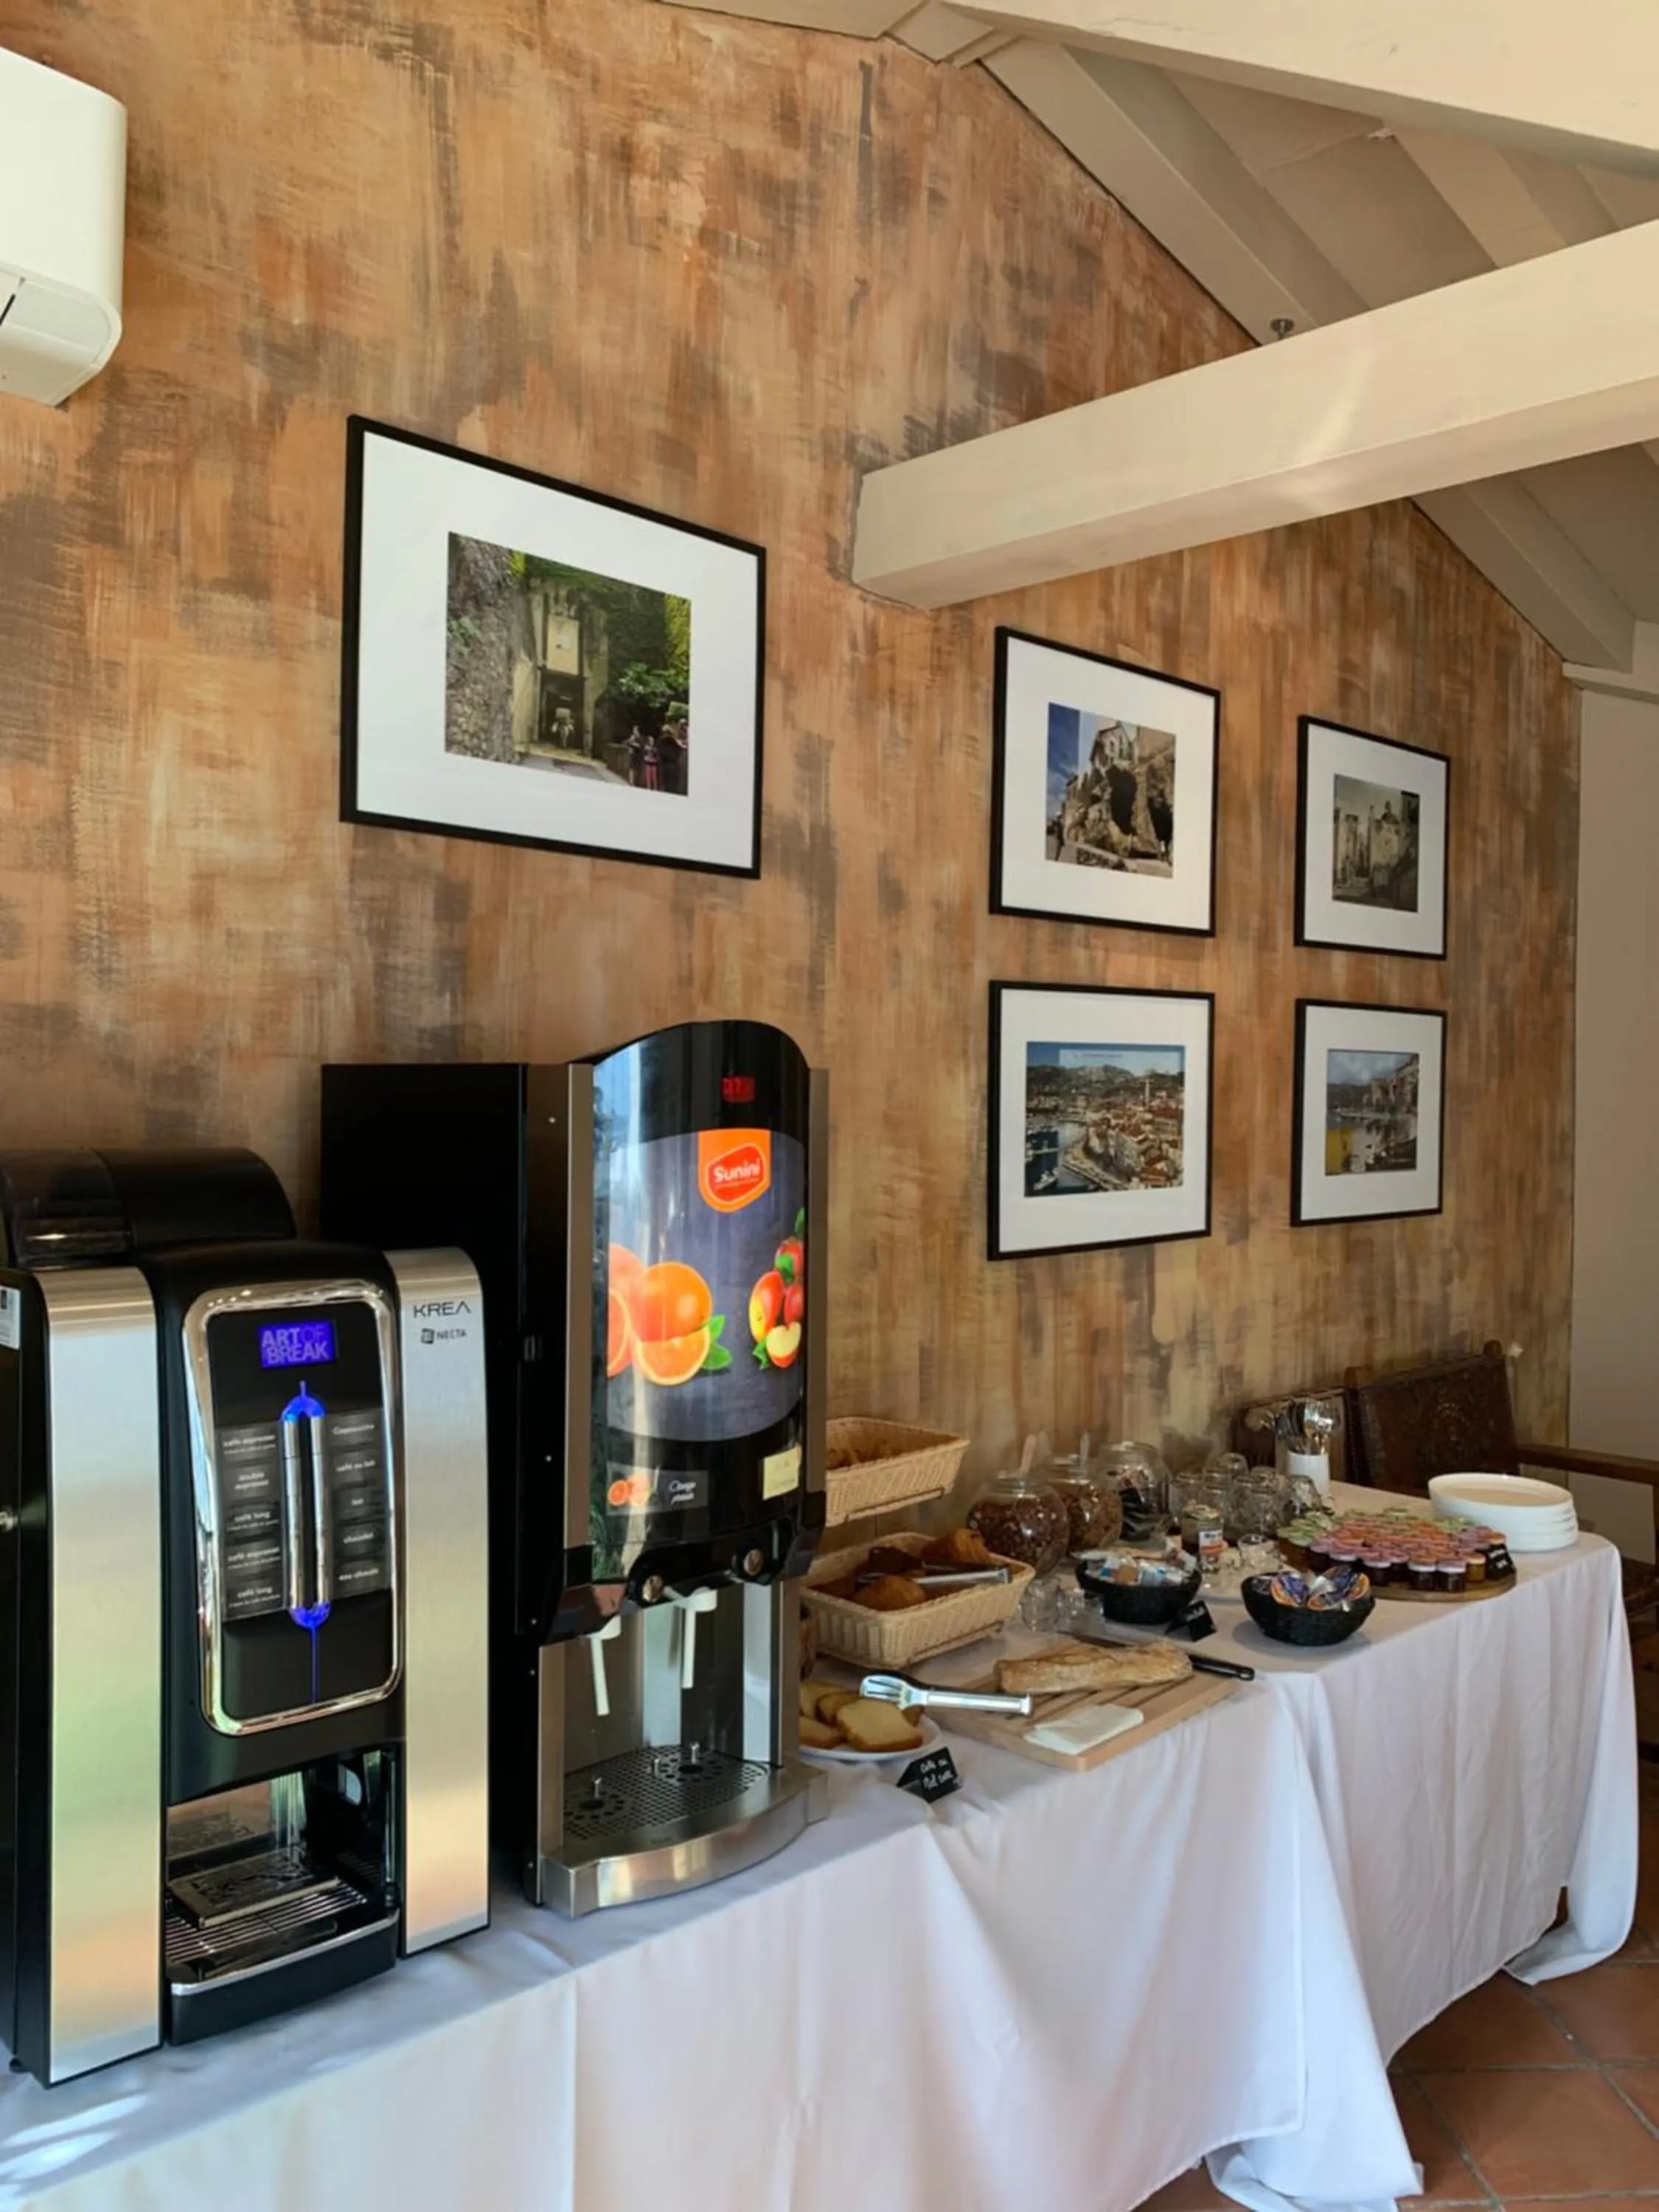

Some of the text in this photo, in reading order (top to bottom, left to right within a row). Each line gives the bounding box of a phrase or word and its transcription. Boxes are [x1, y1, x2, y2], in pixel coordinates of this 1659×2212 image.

[714, 1158, 760, 1183] Sunini
[413, 1301, 471, 1318] KREA
[262, 1328, 299, 1347] ART
[266, 1342, 329, 1365] BREAK
